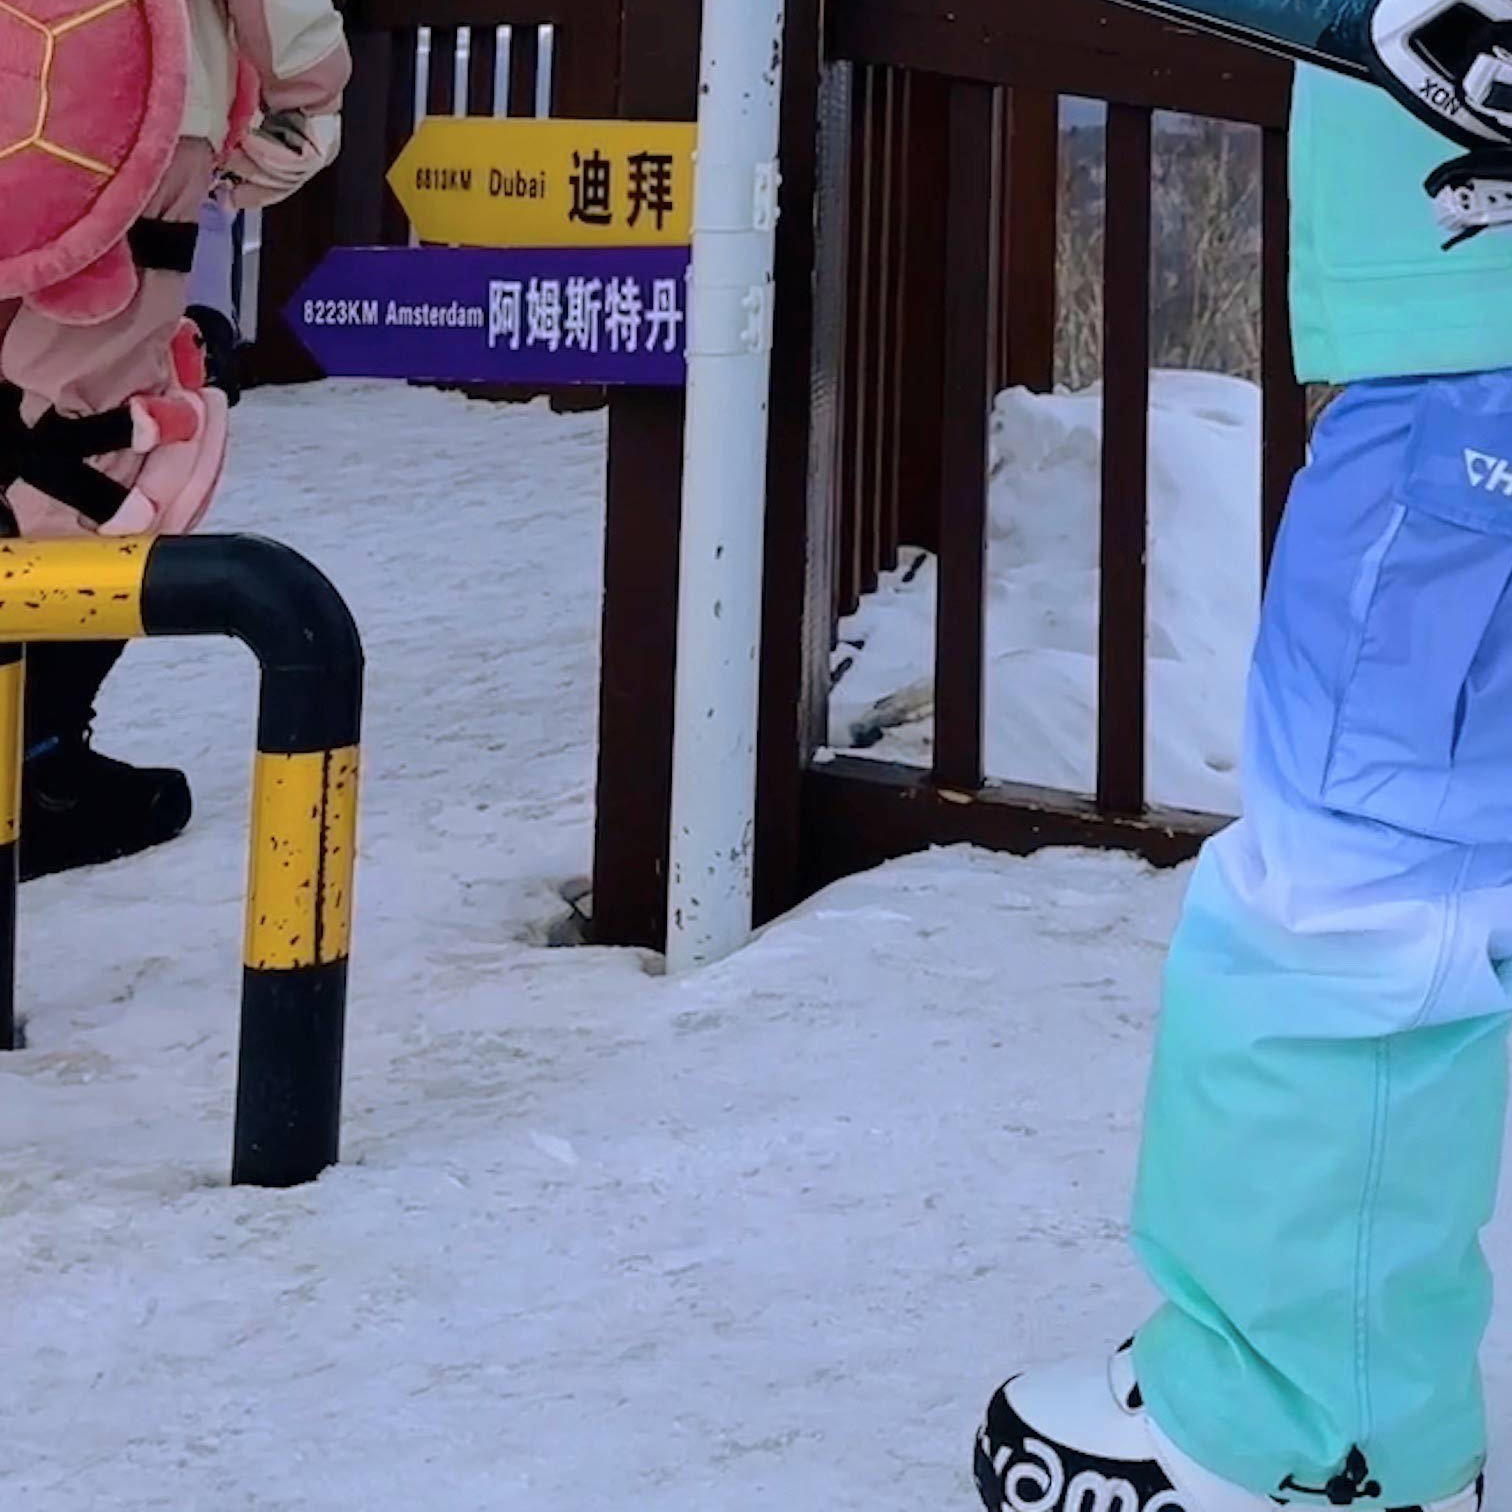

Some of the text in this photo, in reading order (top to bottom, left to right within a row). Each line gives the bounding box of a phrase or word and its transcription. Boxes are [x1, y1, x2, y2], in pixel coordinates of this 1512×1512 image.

[489, 168, 546, 199] Dubai
[568, 149, 674, 231] 迪拜
[303, 276, 683, 352] 8223KM Amsterdam 阿姆斯特丹
